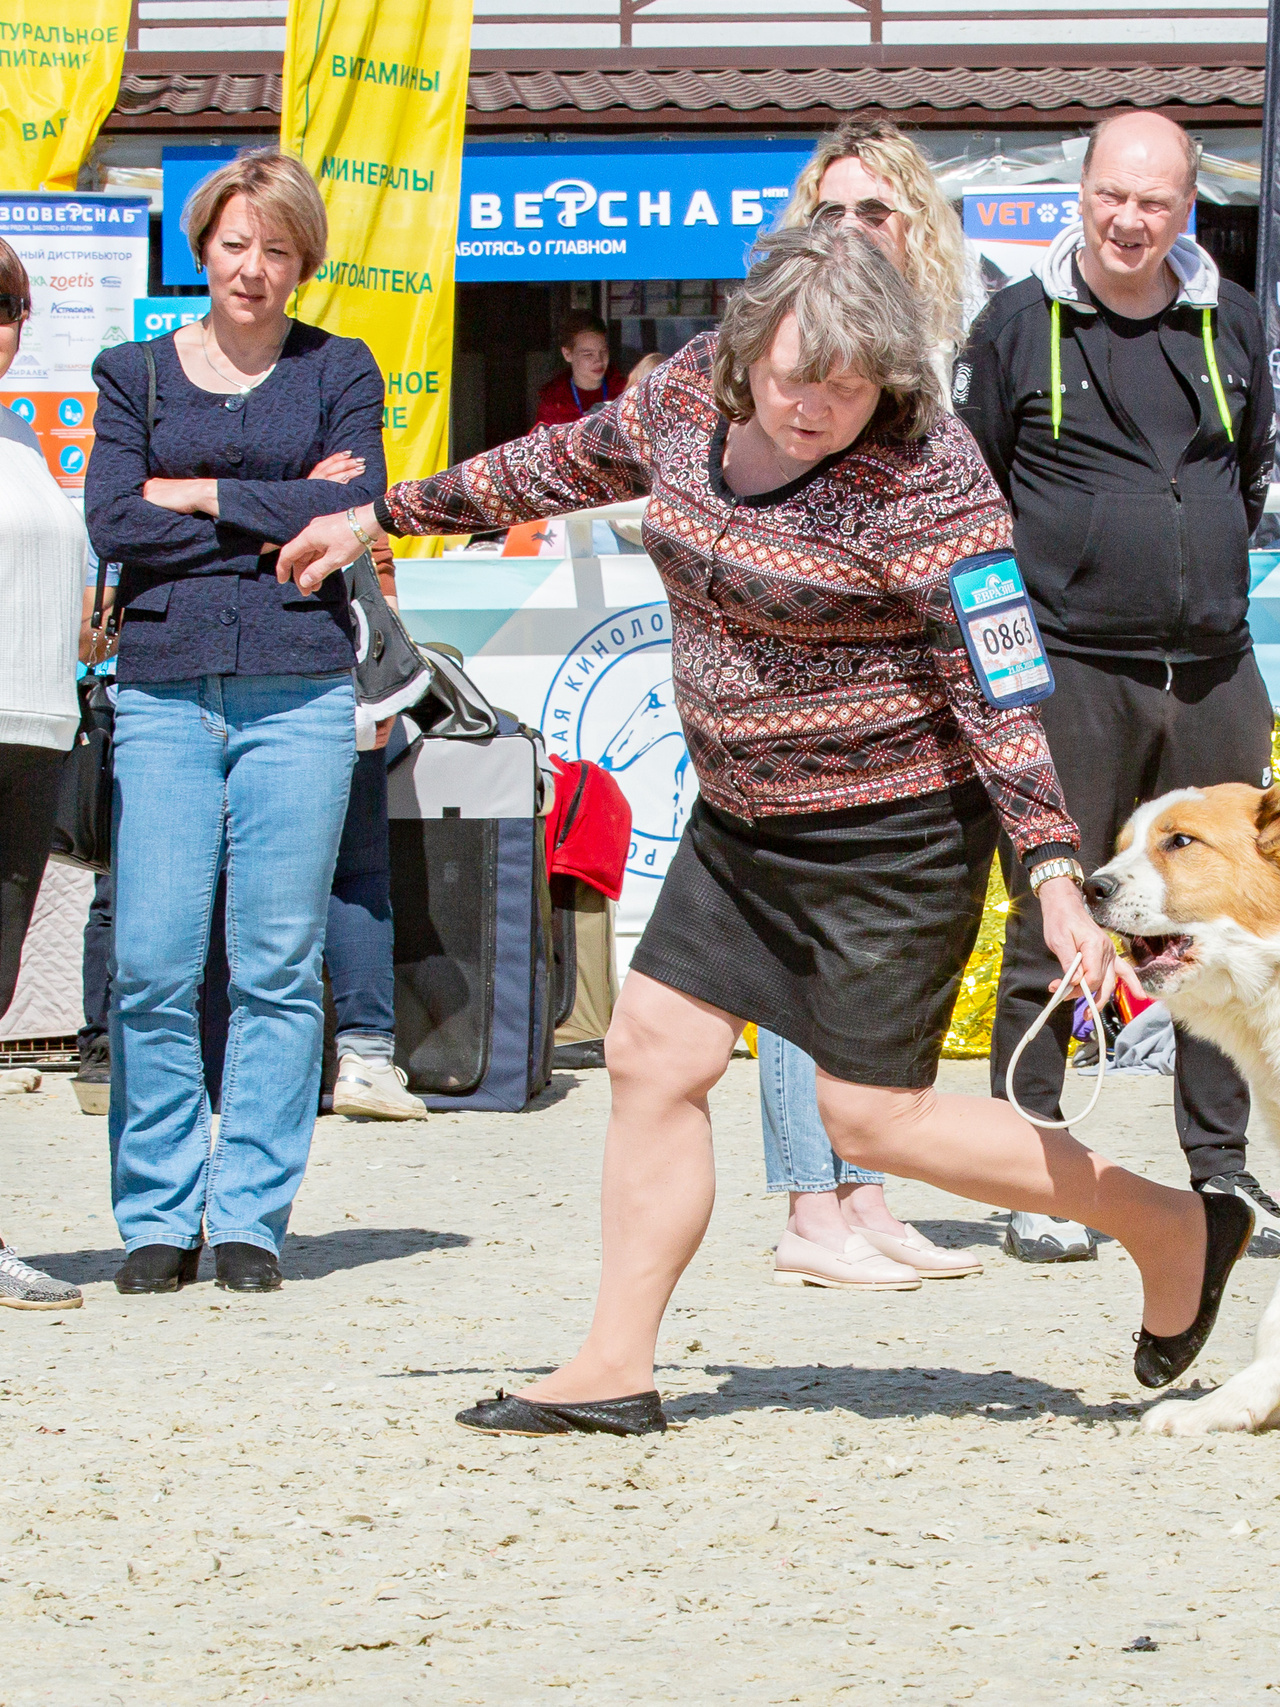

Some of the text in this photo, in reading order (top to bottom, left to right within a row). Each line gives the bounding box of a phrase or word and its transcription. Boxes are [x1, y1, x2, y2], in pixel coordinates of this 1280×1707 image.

[332, 54, 440, 92] ВИТАМИНЫ
[321, 155, 434, 192] МИНЕРАЛЫ
[470, 179, 788, 229] ВЕТСНАБ НПП
[976, 202, 1036, 226] VET
[47, 250, 133, 261] ДИСТРИБЬЮТОР
[528, 240, 542, 256] О
[544, 239, 627, 255] ГЛАВНОМ
[49, 272, 95, 292] zoetis
[315, 261, 433, 294] ФИТОАПТЕКА
[145, 313, 177, 331] ОТ
[974, 583, 1016, 604] ЕВРАЗИЯ
[983, 617, 1032, 655] 0863
